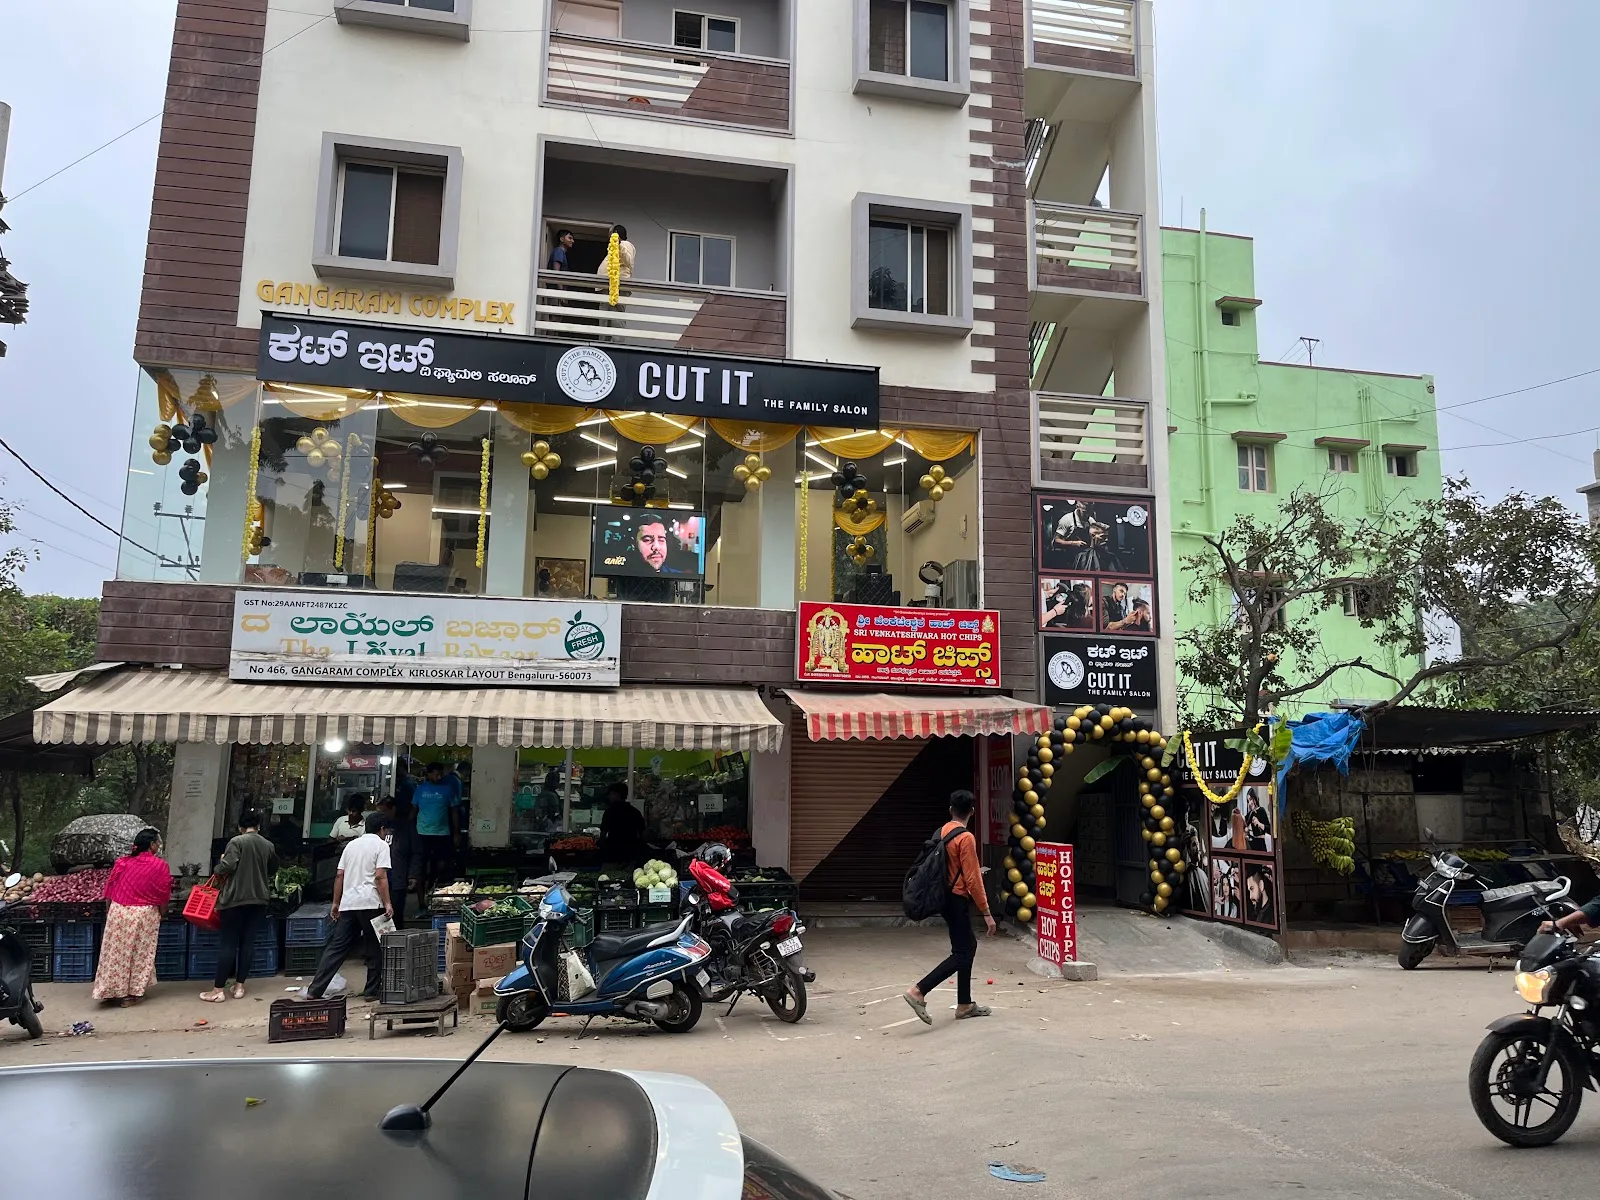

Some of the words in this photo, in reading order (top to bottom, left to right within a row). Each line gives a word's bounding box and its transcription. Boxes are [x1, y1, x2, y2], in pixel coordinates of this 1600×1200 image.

[256, 279, 402, 315] GANGARAM
[409, 294, 515, 325] COMPLEX
[268, 324, 348, 366] ಕಟ್
[357, 337, 435, 374] ಇಟ್
[638, 361, 711, 402] CUT
[721, 369, 754, 406] IT
[763, 398, 784, 409] THE
[789, 400, 828, 413] FAMILY
[833, 404, 869, 416] SALON
[570, 625, 593, 638] ALWAYS
[853, 628, 868, 637] SRI
[870, 629, 938, 641] VENKATESHWARA
[941, 632, 957, 641] HOT
[959, 633, 983, 642] CHIPS
[571, 635, 599, 649] FRESH
[1087, 643, 1116, 659] ಕಟ್
[1119, 645, 1149, 661] ಇಟ್
[851, 640, 927, 667] ಹಾಟ್
[932, 642, 992, 679] ಚಿಪ್ಸ್
[250, 665, 264, 674] No
[266, 666, 288, 675] 466,
[291, 666, 353, 677] GANGARAM
[356, 667, 403, 677] COMPLEX
[409, 668, 464, 679] KIRLOSKAR
[467, 670, 505, 680] LAYOUT
[508, 671, 592, 682] Bengaluru-560073
[1087, 672, 1116, 689] CUT
[1119, 673, 1132, 690] IT
[1204, 740, 1217, 767] IT
[1215, 769, 1238, 779] SALON
[1059, 851, 1072, 893] HOT
[1040, 915, 1058, 938] HOT
[1039, 937, 1060, 963] CHIPS
